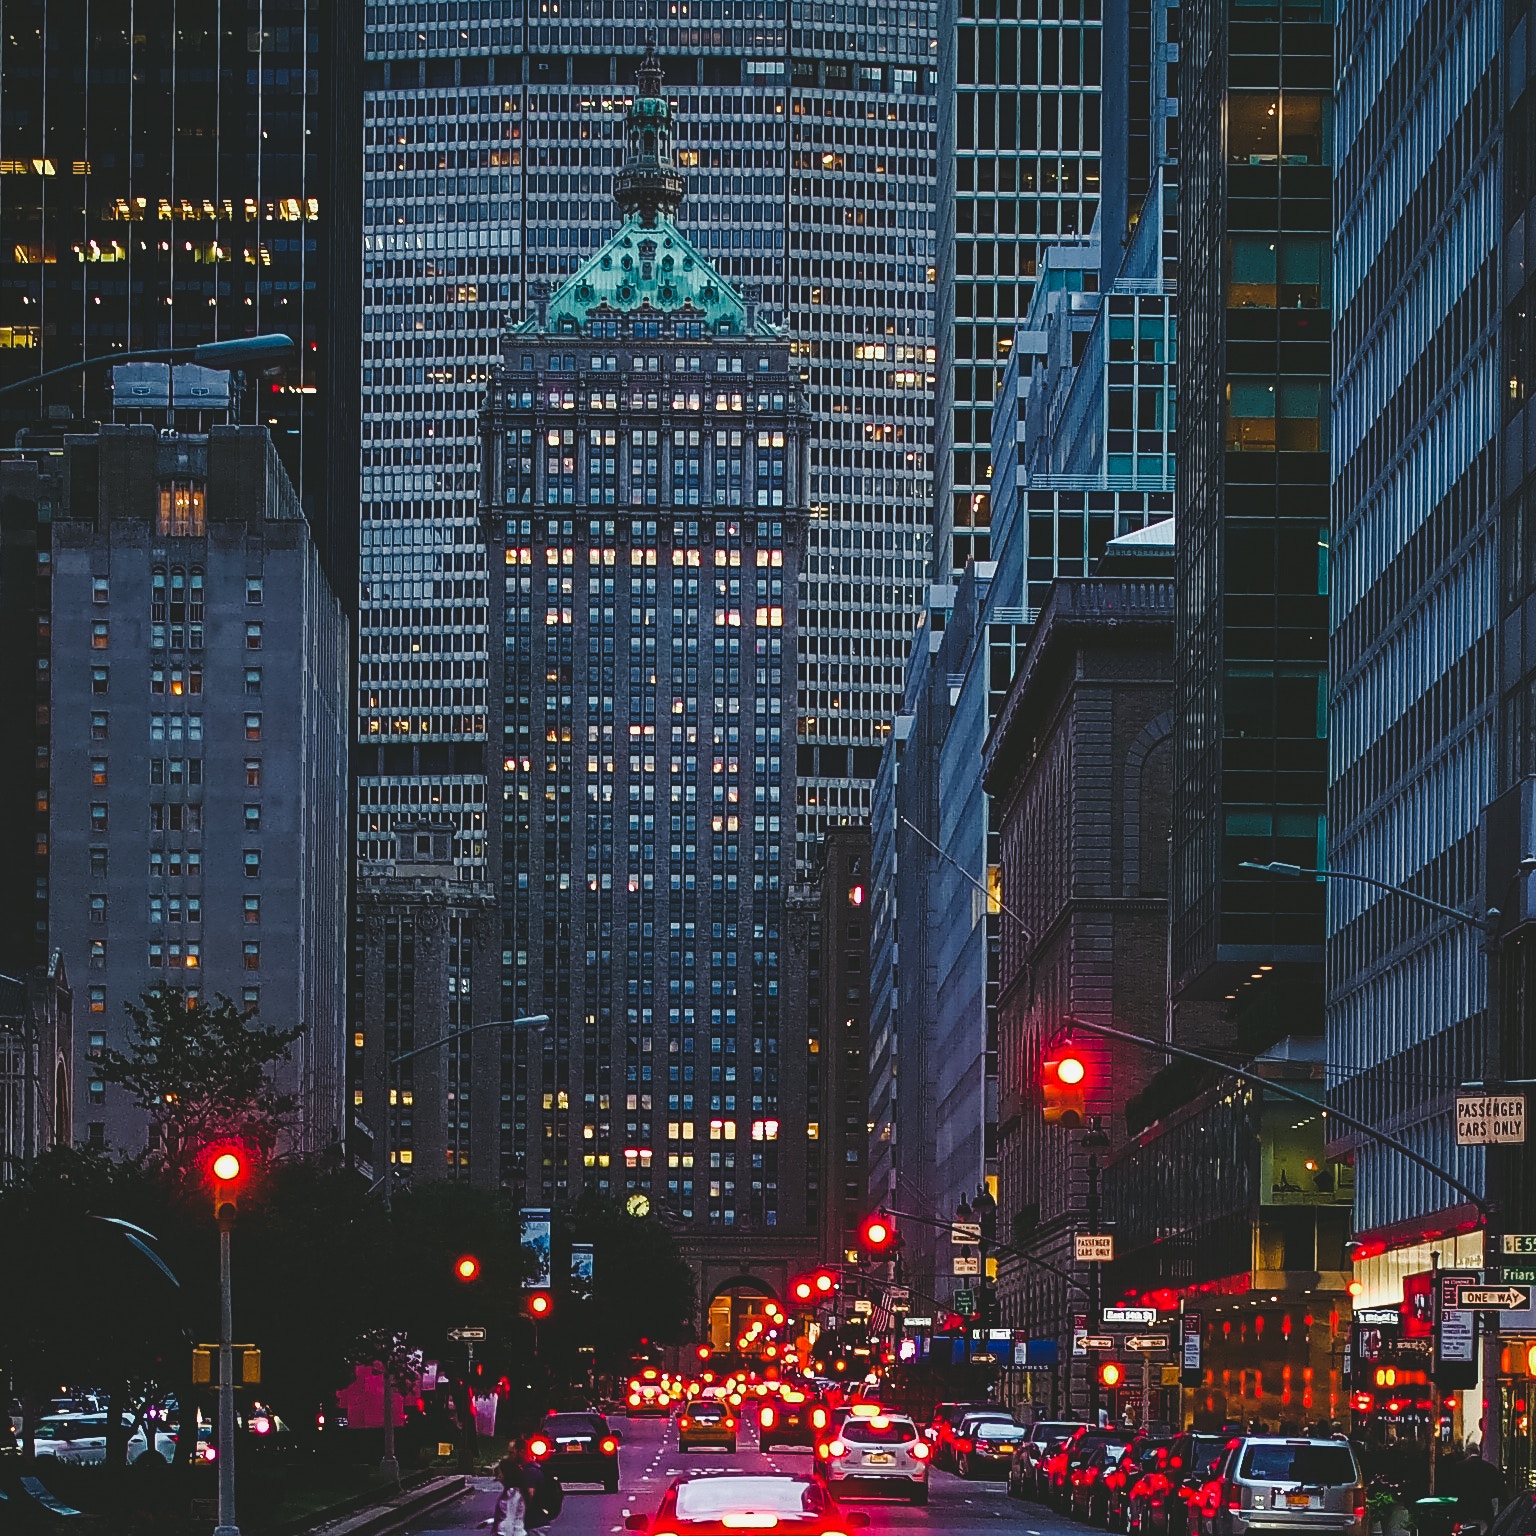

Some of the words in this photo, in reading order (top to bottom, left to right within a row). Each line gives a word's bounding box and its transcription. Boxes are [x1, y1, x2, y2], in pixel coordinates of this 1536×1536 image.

[1458, 1102, 1522, 1118] PASSENGER
[1458, 1122, 1487, 1136] CARS
[1493, 1121, 1522, 1135] ONLY
[1077, 1238, 1110, 1247] PASSENGER
[1515, 1239, 1522, 1251] E
[1077, 1248, 1094, 1256] CARS
[1095, 1248, 1110, 1256] ONLY
[1503, 1268, 1535, 1280] Friars
[1467, 1292, 1488, 1303] ONE
[1497, 1292, 1520, 1303] WAY
